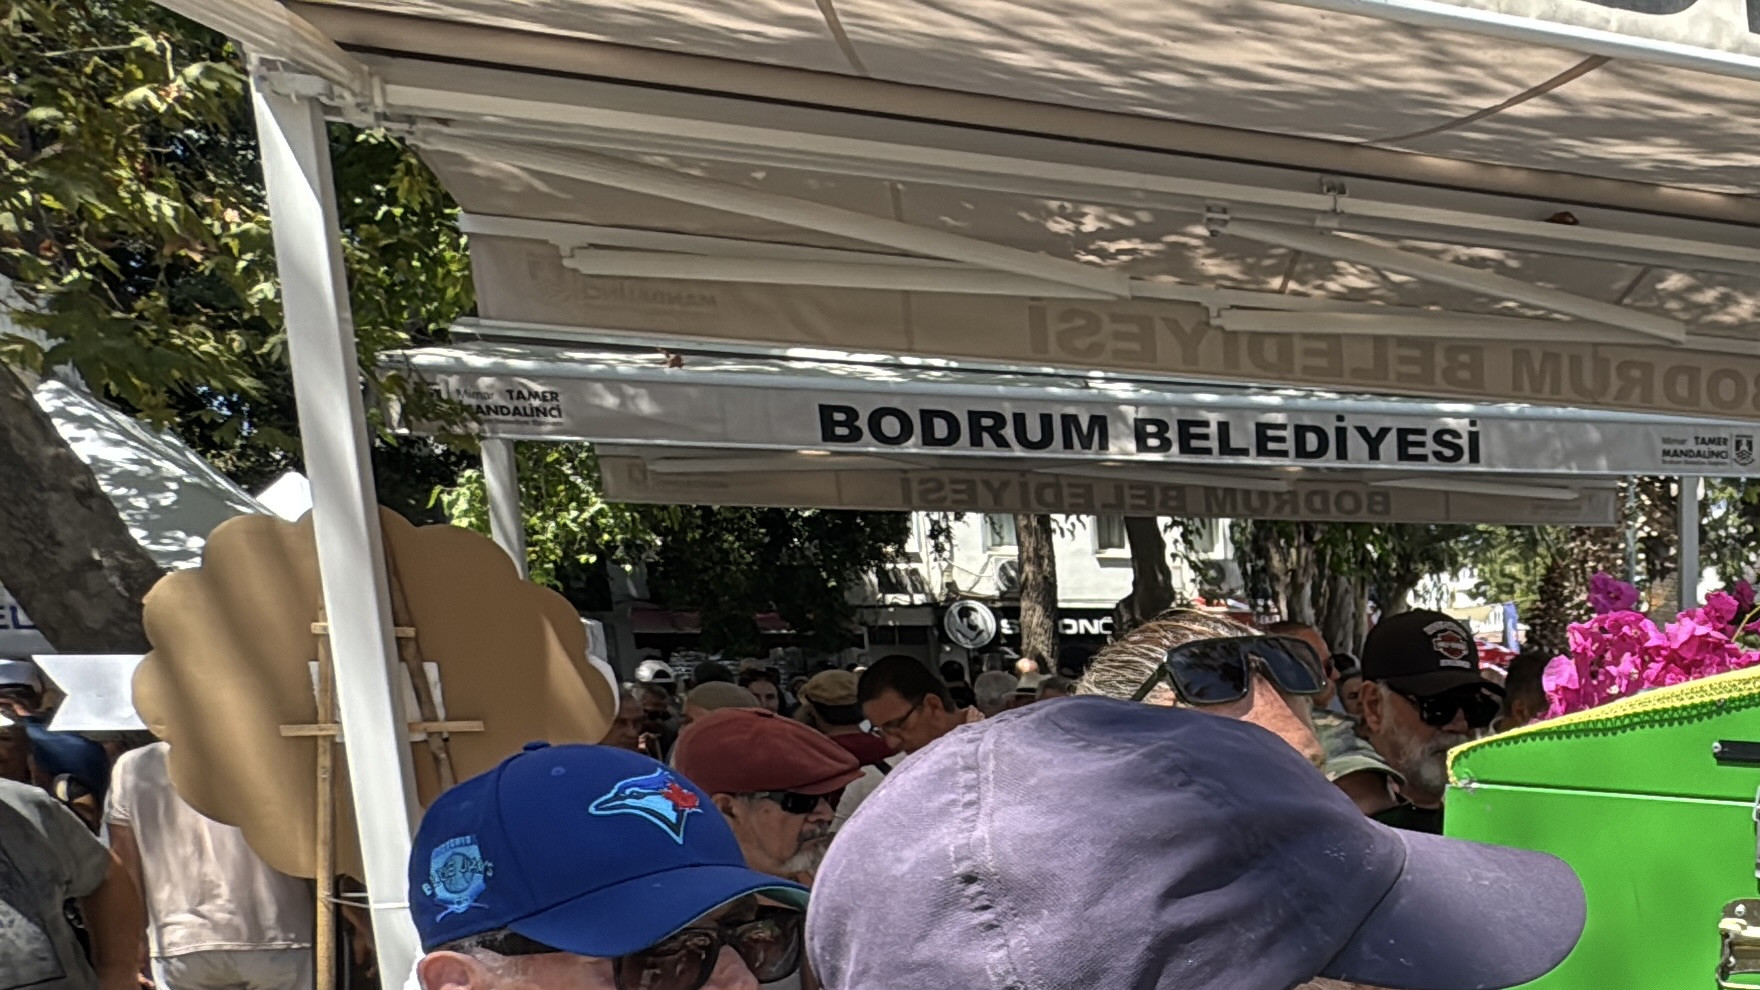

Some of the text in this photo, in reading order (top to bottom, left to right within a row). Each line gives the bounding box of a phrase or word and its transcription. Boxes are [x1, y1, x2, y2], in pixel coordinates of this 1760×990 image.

[505, 389, 559, 402] TAMER
[464, 402, 562, 418] ANDALİNCİ
[818, 404, 1481, 464] BODRUM BELEDİYESİ
[1694, 436, 1728, 446] TAMER
